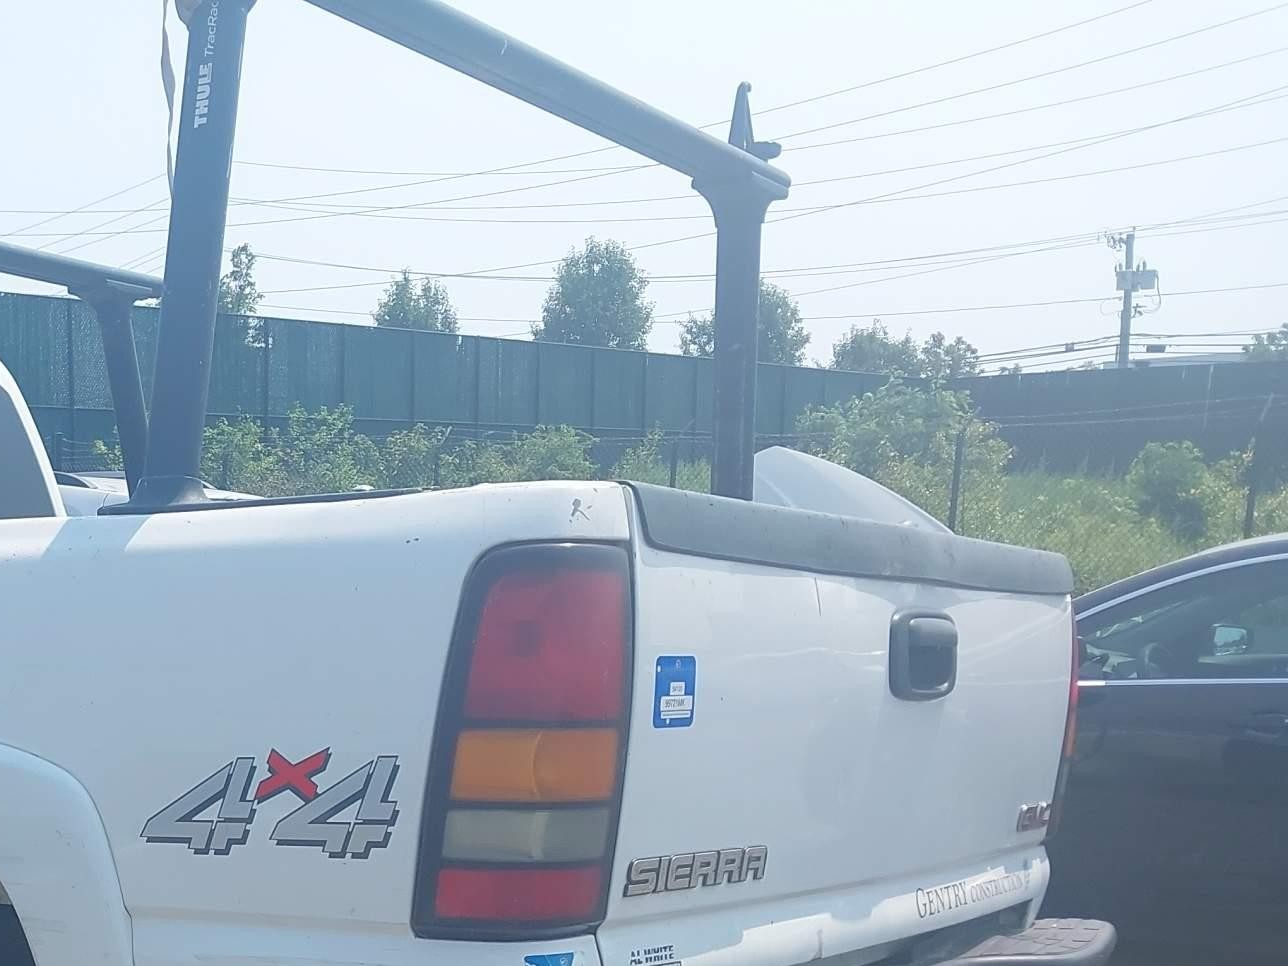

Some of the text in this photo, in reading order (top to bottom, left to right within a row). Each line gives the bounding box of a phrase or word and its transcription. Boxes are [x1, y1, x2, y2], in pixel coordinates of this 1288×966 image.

[194, 62, 212, 128] THULE
[623, 845, 768, 897] SIERRA
[630, 945, 675, 966] AL WHITE
